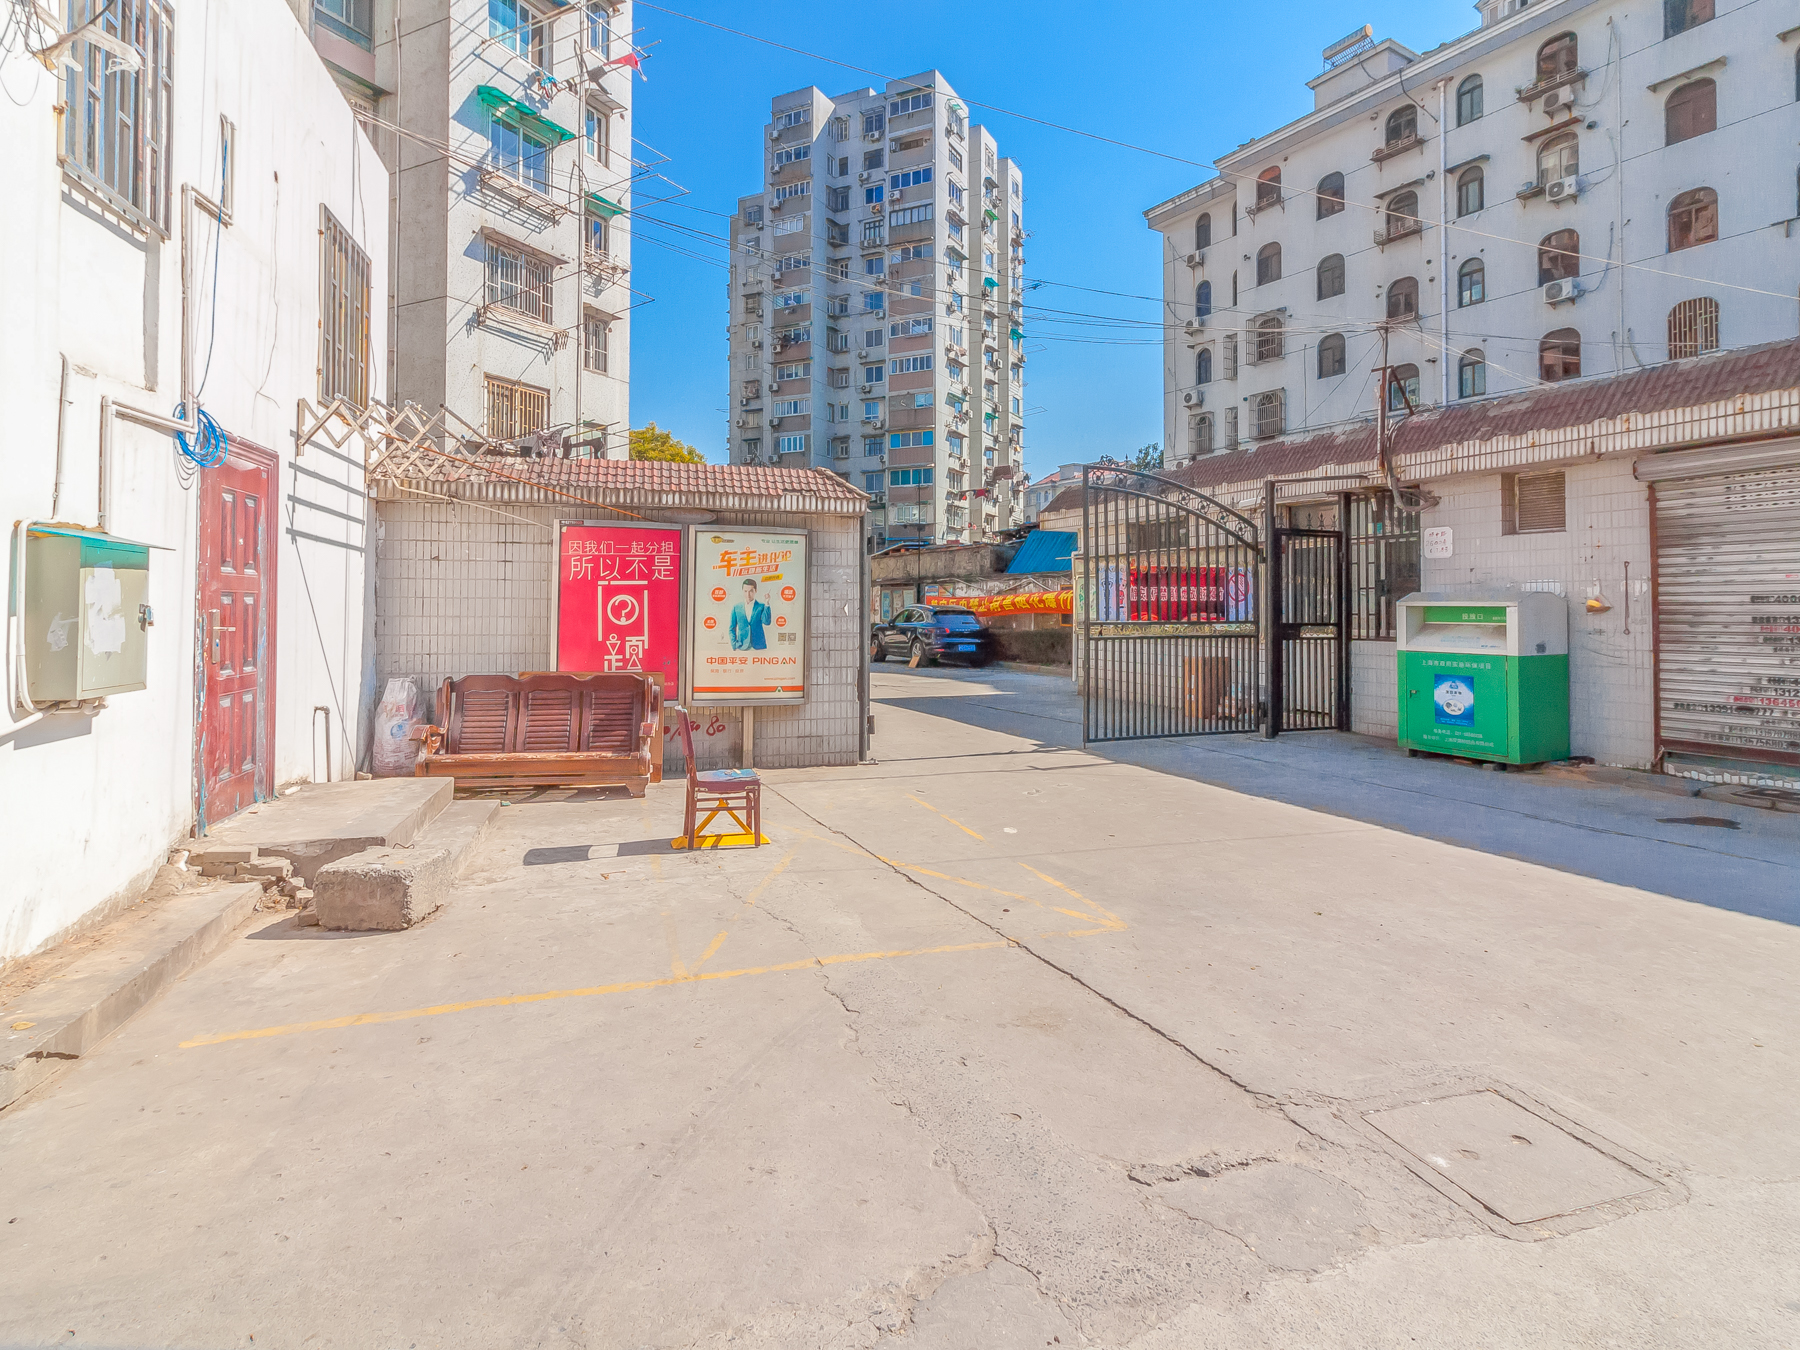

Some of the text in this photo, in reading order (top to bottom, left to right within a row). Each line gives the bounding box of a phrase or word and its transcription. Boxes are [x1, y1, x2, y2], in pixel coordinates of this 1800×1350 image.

[568, 540, 674, 554] 因我们一起分担
[569, 556, 674, 580] 所以不是
[706, 656, 748, 665] 中国平安
